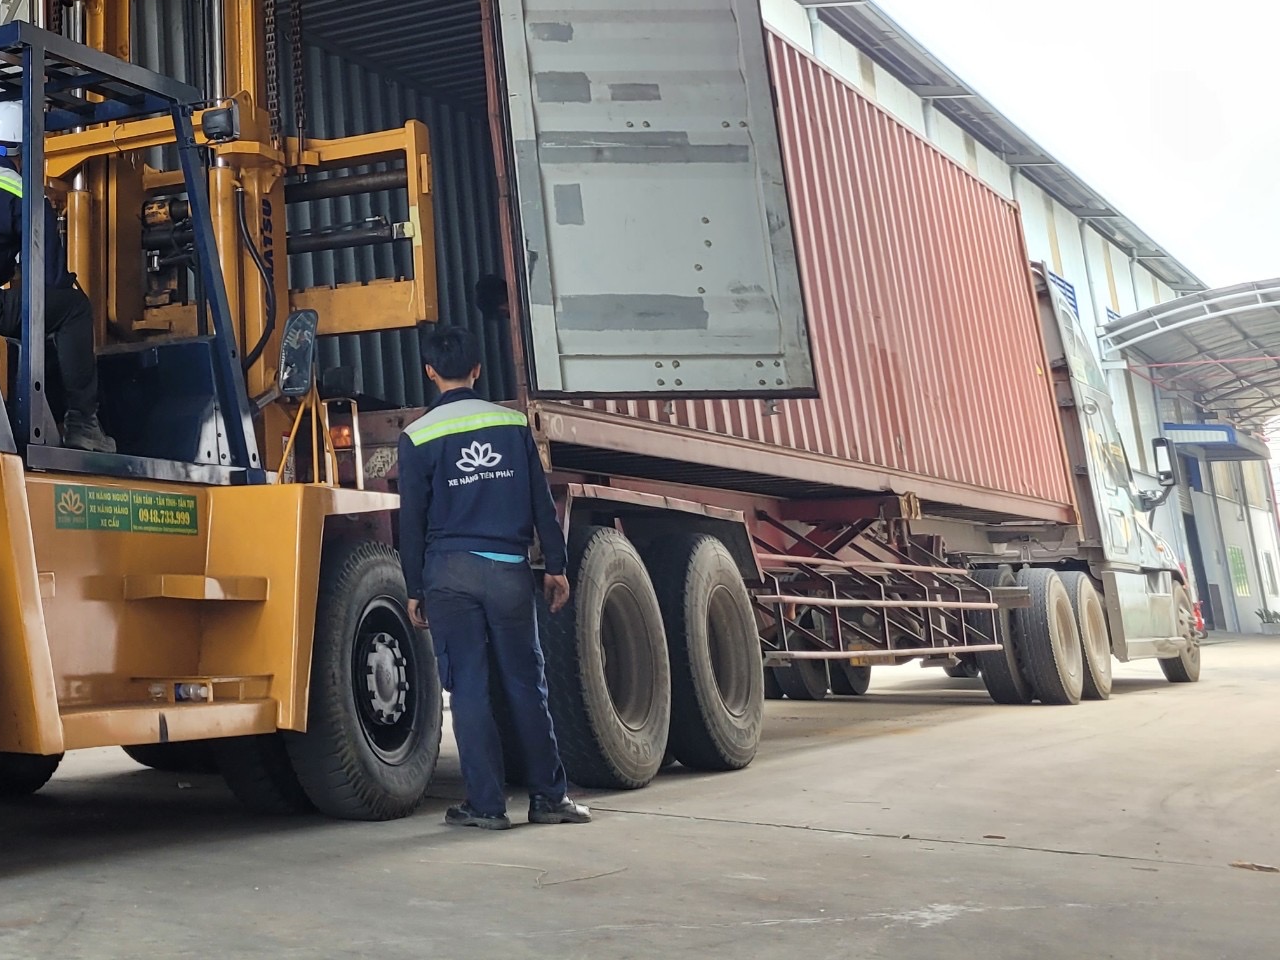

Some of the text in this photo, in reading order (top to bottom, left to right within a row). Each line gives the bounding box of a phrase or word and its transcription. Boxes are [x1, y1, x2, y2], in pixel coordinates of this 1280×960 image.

[448, 478, 459, 487] XE
[495, 468, 514, 478] PHÁT
[138, 507, 190, 525] 0948.733.999
